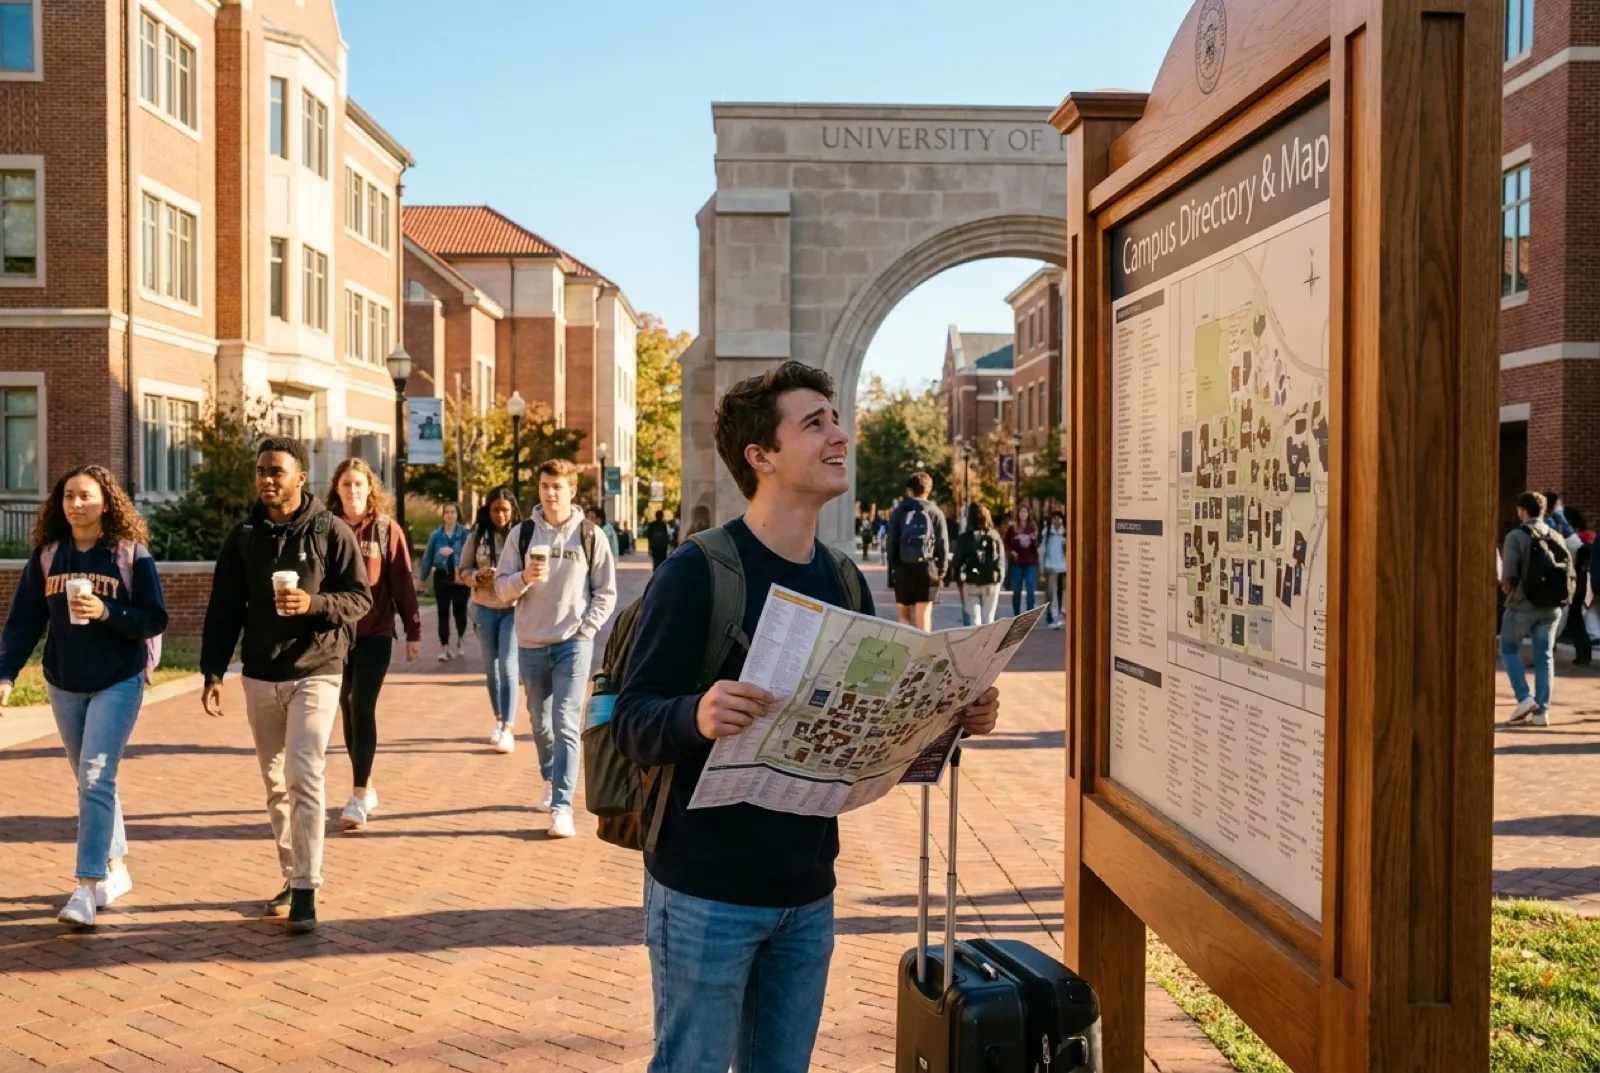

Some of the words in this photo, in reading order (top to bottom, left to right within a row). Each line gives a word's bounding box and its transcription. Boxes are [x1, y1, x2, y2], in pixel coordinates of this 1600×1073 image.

[821, 126, 996, 151] UNIVERSITY
[1008, 129, 1043, 151] OF
[1123, 220, 1176, 275] Campus
[1180, 174, 1257, 246] Directory
[1260, 153, 1276, 202] &
[1280, 134, 1329, 193] Map
